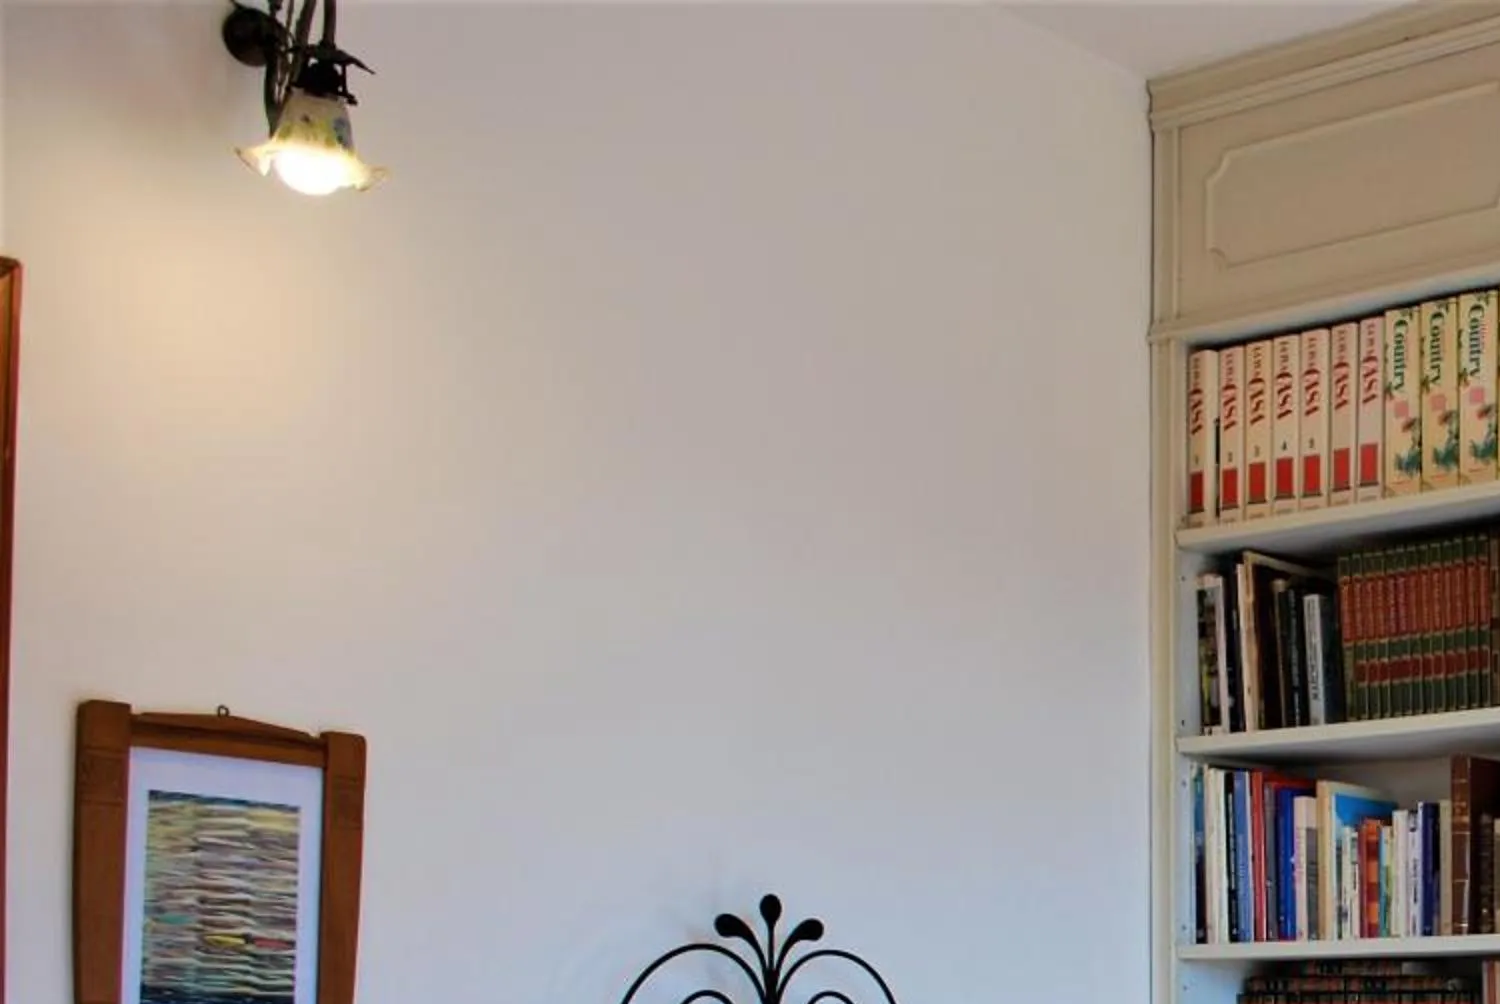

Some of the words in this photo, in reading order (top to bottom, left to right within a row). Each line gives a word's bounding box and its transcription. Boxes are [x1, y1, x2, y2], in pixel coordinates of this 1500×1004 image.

[1393, 319, 1409, 392] Country
[1429, 311, 1445, 386] Country
[1468, 302, 1485, 379] Country
[1249, 377, 1265, 426] CASA
[1277, 372, 1293, 420] CASA
[1304, 368, 1321, 417] CASA
[1334, 361, 1350, 411] CASA
[1362, 356, 1379, 404] CASA
[1189, 387, 1204, 436] CASA
[1222, 384, 1239, 431] CASA
